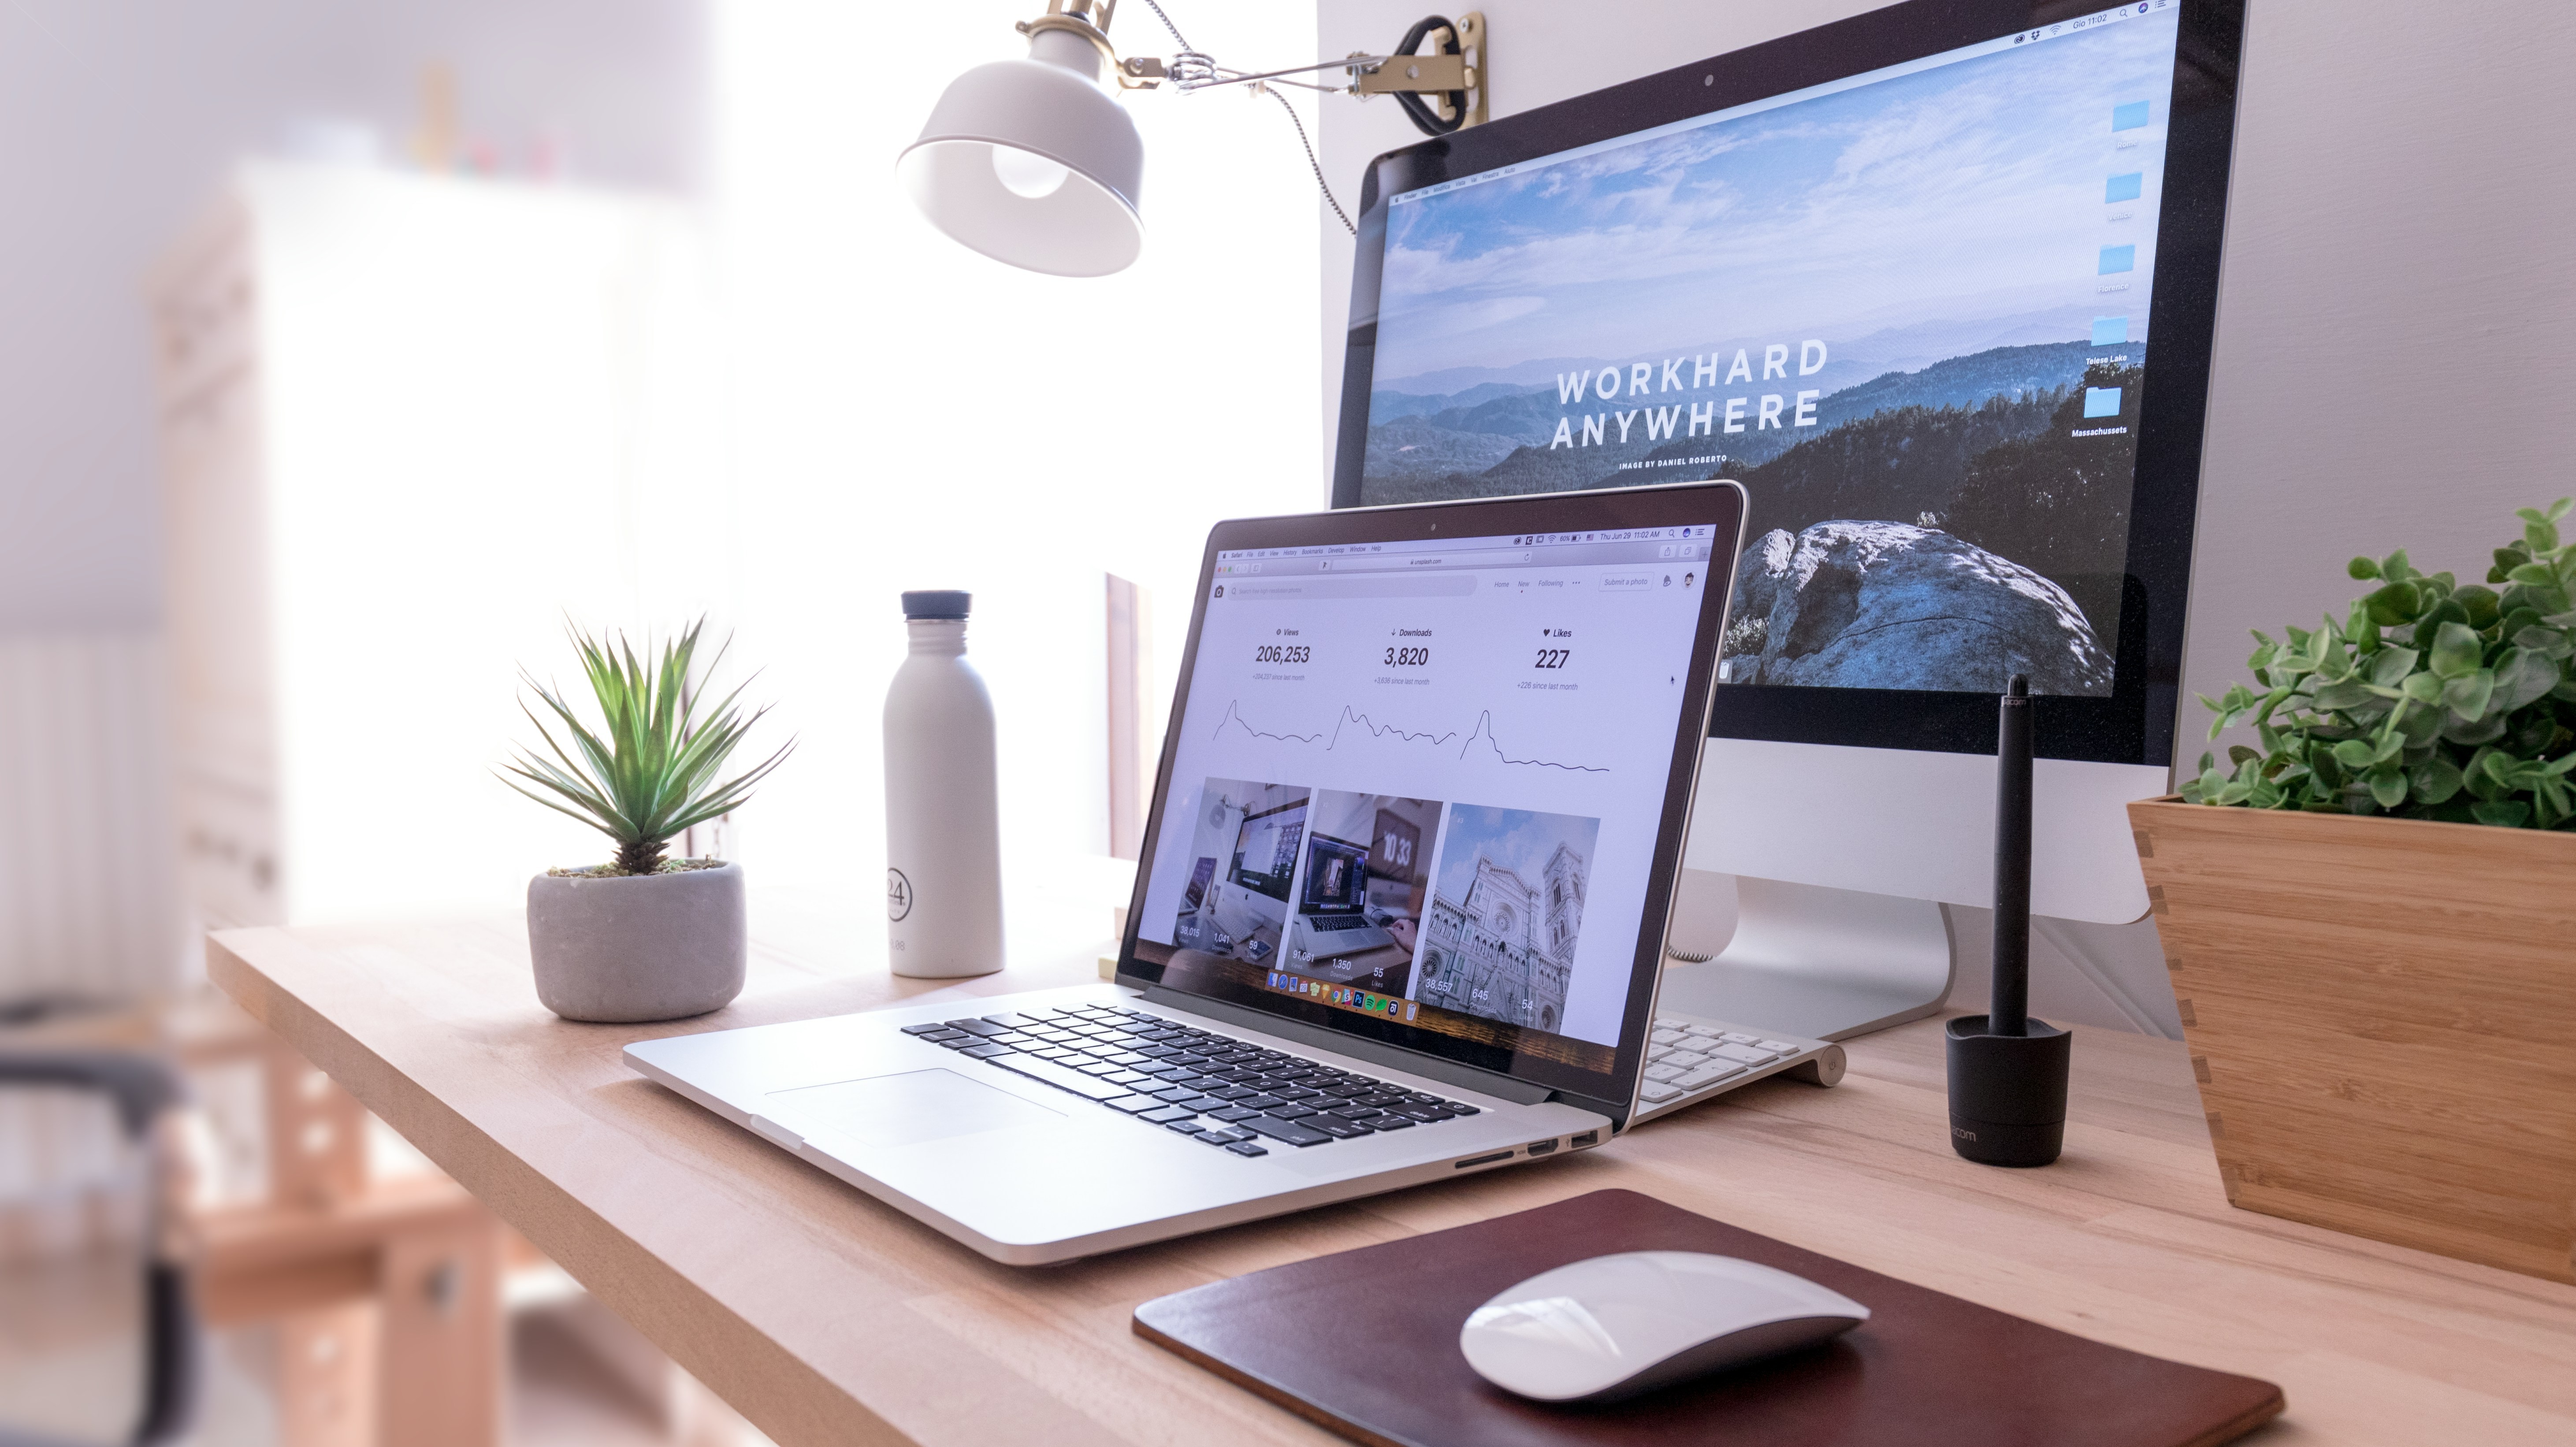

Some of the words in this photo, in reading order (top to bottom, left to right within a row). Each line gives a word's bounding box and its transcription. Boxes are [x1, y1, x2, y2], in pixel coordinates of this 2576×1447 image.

[2073, 20, 2085, 29] Gio
[2088, 14, 2107, 26] 11:02
[2117, 140, 2137, 149] Rome
[1482, 171, 1499, 180] Finestra
[2108, 212, 2132, 221] Venice
[2098, 283, 2129, 293] Florence
[2110, 354, 2127, 363] Lake
[1557, 339, 1828, 404] WORKHARD
[1550, 389, 1820, 450] ANYWHERE
[2072, 426, 2127, 437] Massachussets
[1658, 458, 1686, 467] DANIEL
[1689, 454, 1727, 464] ROBERTO
[1538, 579, 1564, 587] Following
[1630, 578, 1648, 586] photo
[1399, 628, 1432, 637] Downloads
[1553, 629, 1572, 638] Likes
[1255, 646, 1311, 665] 206,253
[1384, 647, 1429, 668] 3,820
[1535, 649, 1570, 669] 227
[1180, 926, 1200, 937] 38,015
[1214, 933, 1230, 944] 1,041
[1249, 940, 1258, 950] 59
[1293, 950, 1315, 963] 91,061
[1332, 958, 1352, 971] 1,350
[1330, 971, 1353, 981] Downloads
[1373, 967, 1384, 978] 55
[1425, 978, 1453, 992] 38,557
[1355, 994, 1362, 1003] Ps
[1423, 992, 1438, 1000] Views
[1472, 988, 1489, 1001] 645
[1470, 1002, 1497, 1014] Downloads
[1522, 999, 1533, 1010] 54
